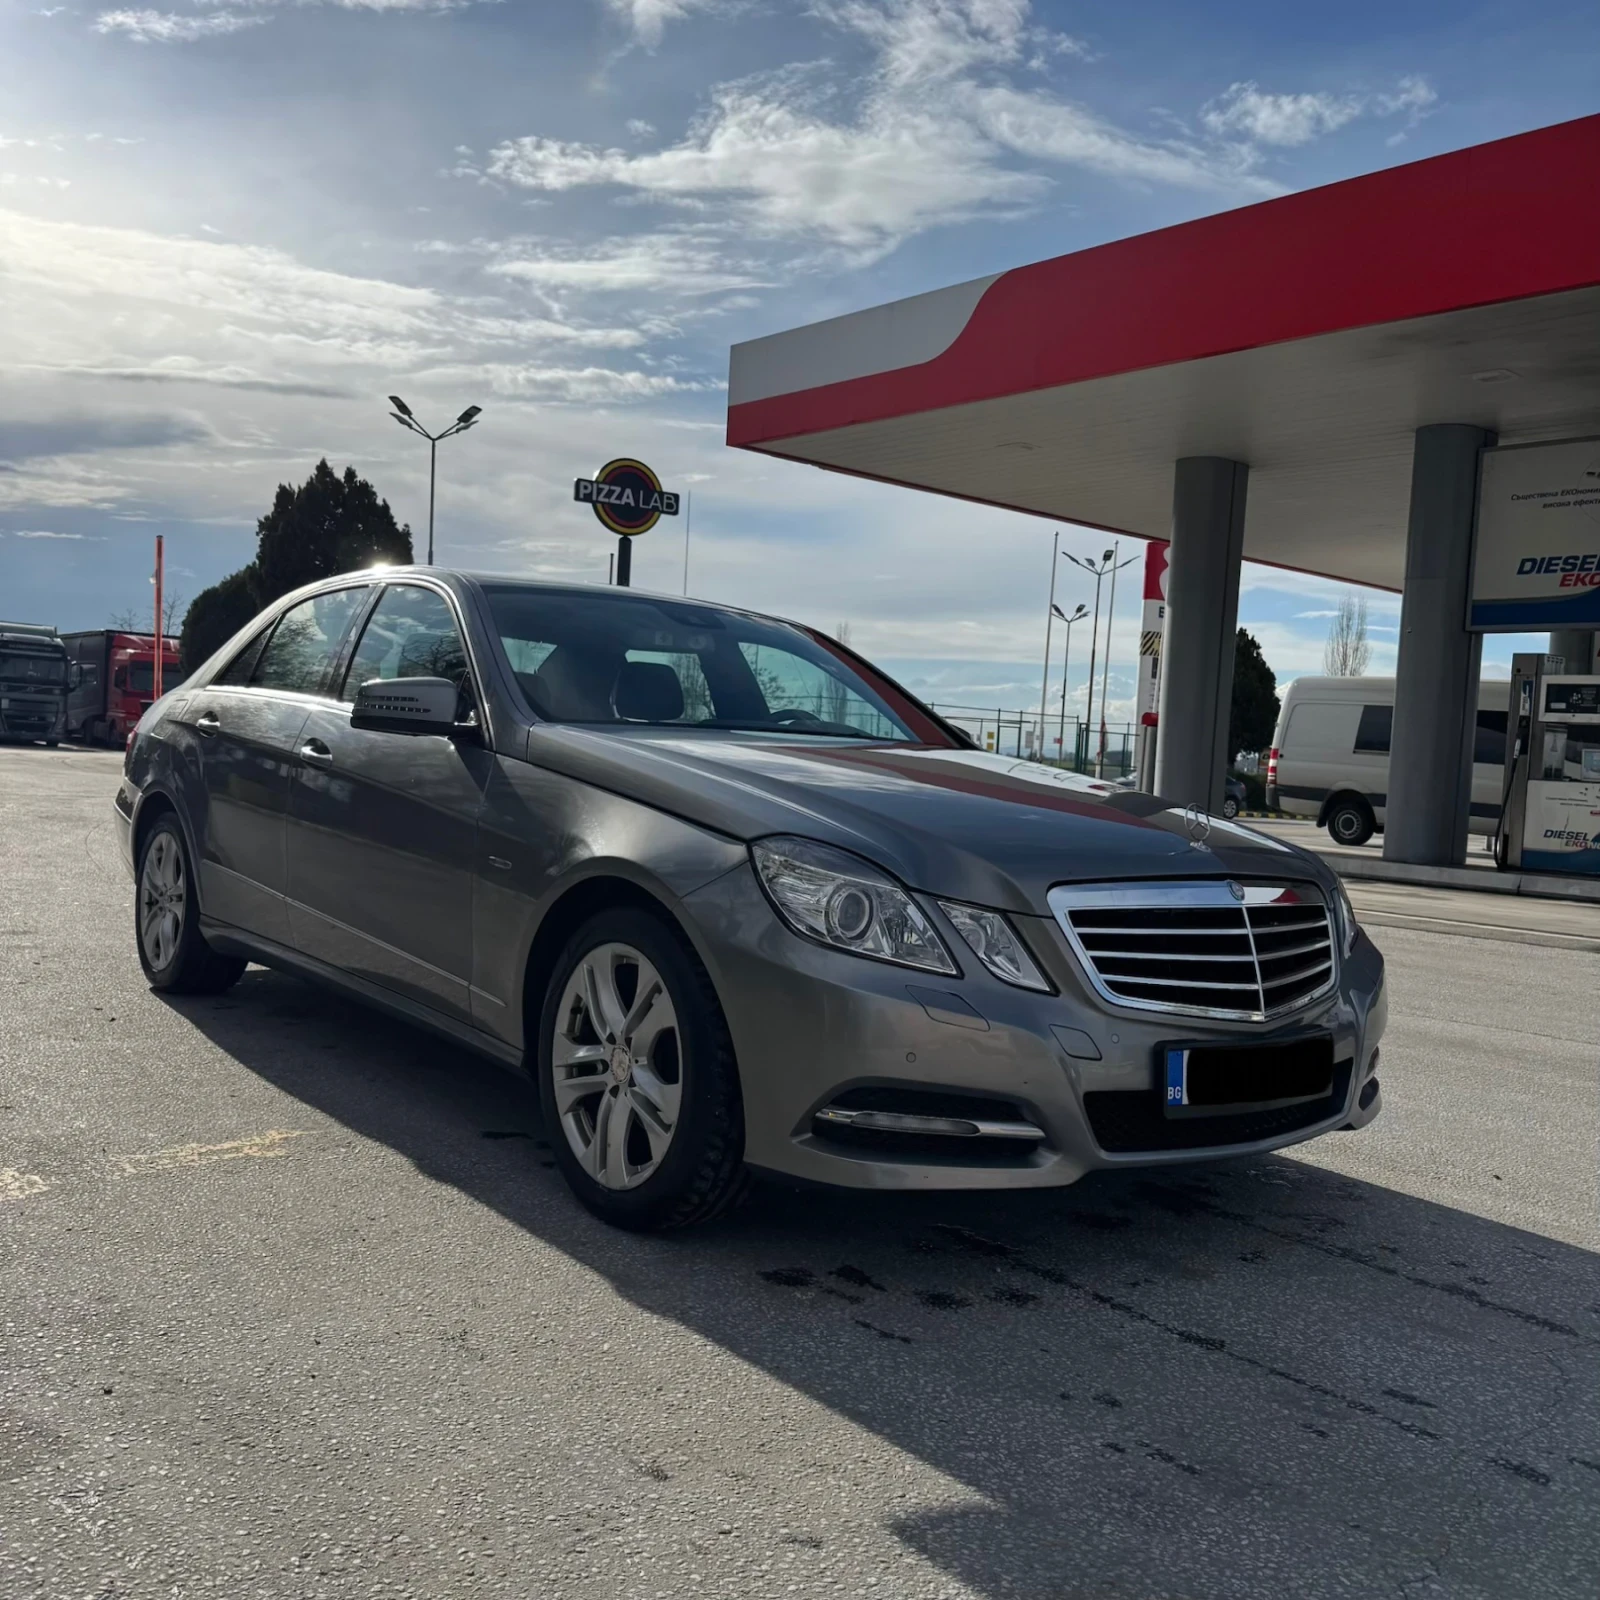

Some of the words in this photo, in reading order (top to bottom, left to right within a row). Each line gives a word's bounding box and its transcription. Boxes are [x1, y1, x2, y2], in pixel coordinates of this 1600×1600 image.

[579, 481, 635, 507] PIZZA
[639, 489, 677, 512] LAB
[1543, 829, 1590, 842] DIESEL
[1167, 1086, 1182, 1099] BG
